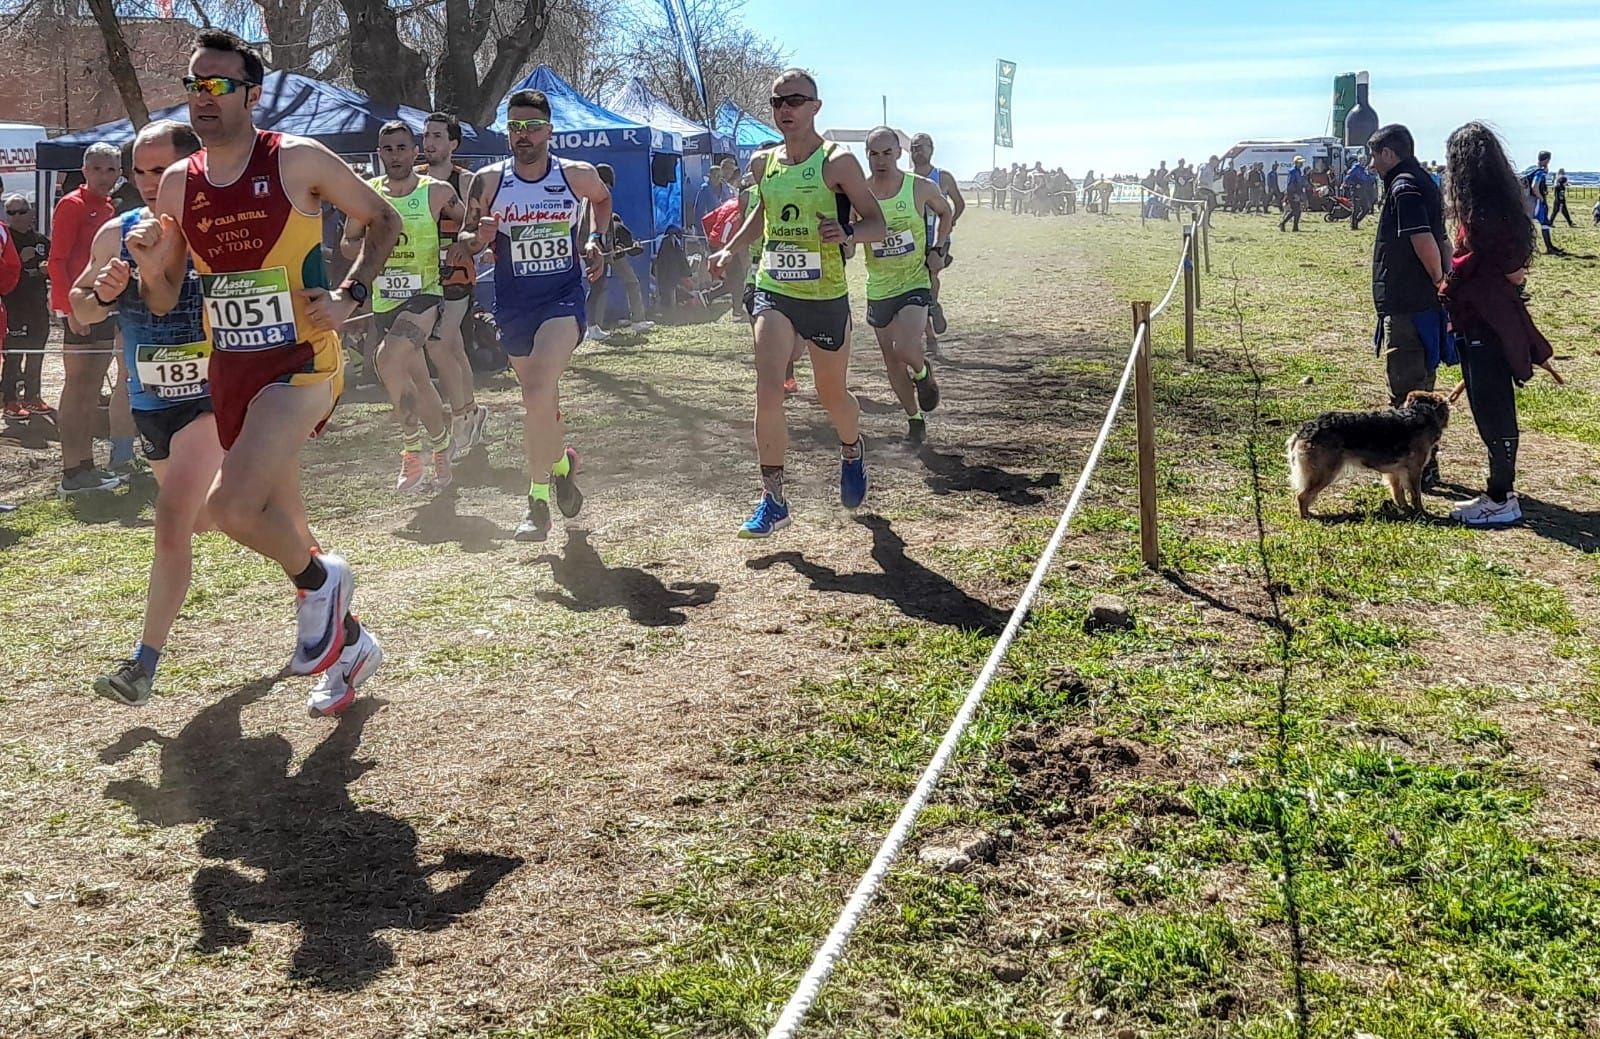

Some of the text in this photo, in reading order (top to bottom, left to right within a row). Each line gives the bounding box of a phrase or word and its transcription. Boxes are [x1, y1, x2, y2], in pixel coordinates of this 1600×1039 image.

[548, 131, 610, 149] RIOJA
[214, 210, 268, 226] CAJA RURAL
[215, 227, 249, 243] VINO
[771, 226, 809, 236] Adarsa
[207, 238, 263, 258] DE TORO
[516, 239, 569, 260] 1038
[882, 235, 903, 248] 305
[776, 254, 807, 268] 303
[386, 277, 410, 289] 302
[210, 295, 282, 327] 1051
[156, 362, 199, 383] 183
